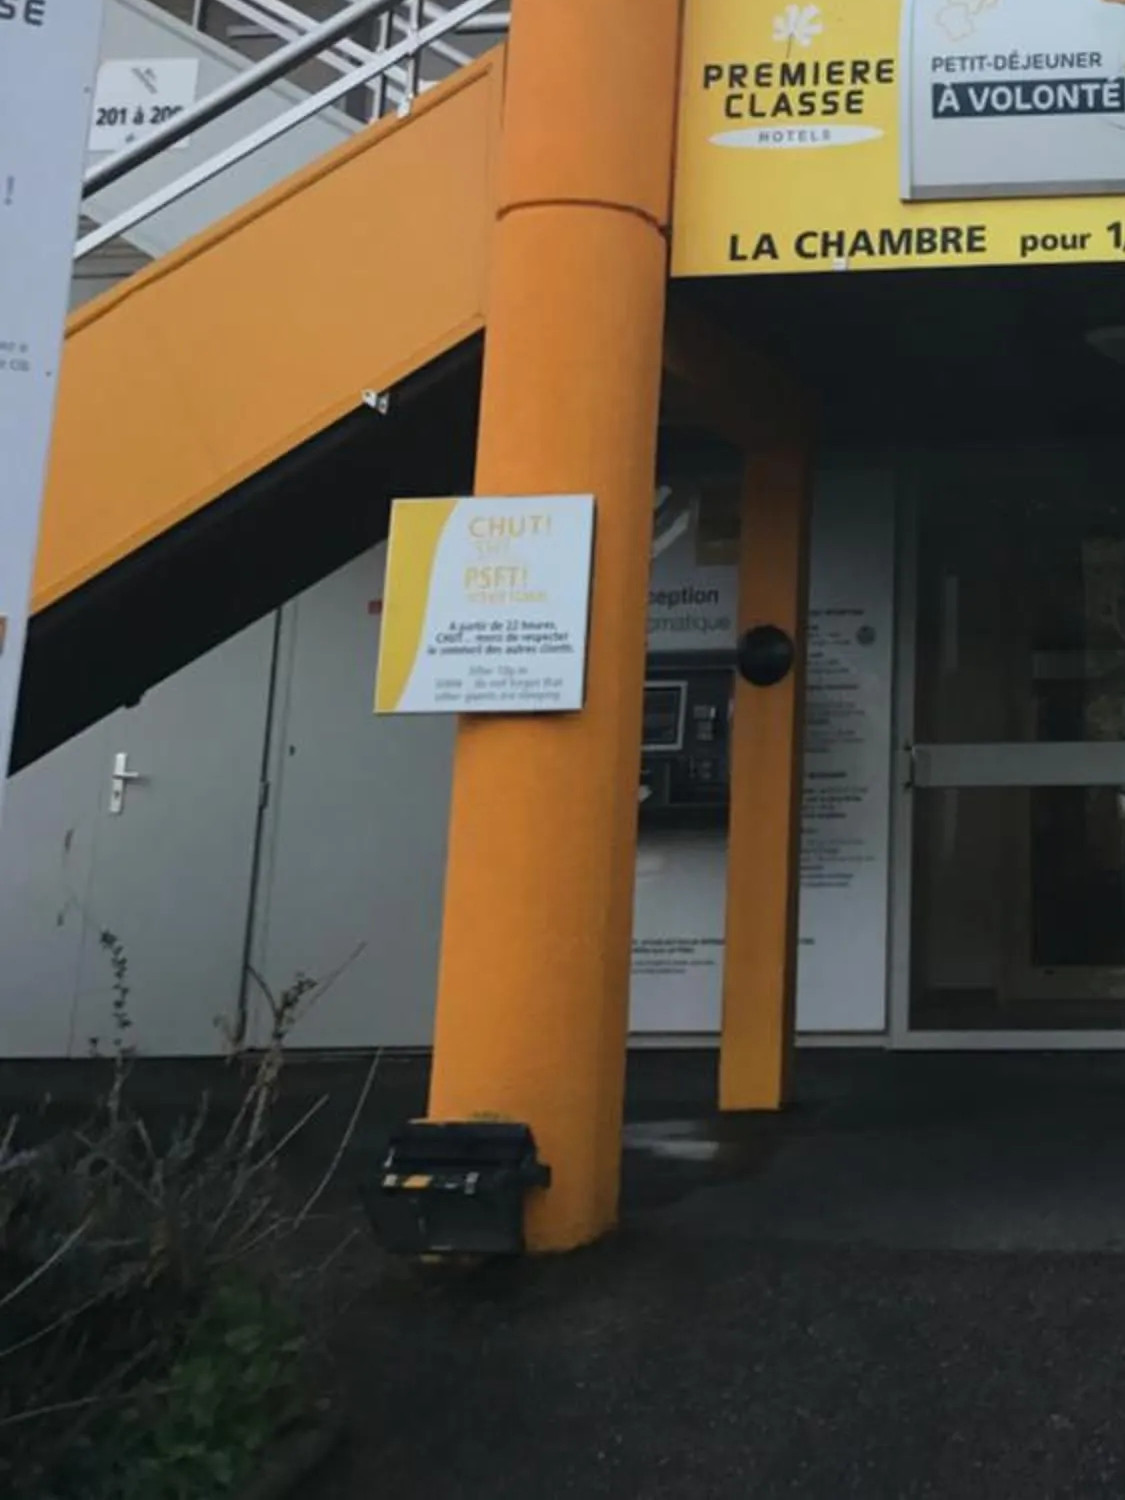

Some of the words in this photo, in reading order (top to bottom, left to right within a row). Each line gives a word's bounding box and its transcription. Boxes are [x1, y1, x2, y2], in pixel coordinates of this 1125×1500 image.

[703, 59, 895, 89] PREMIERE
[931, 50, 1103, 73] PETIT-DÉJEUNER
[725, 89, 864, 119] CLASSE
[937, 82, 961, 113] À
[968, 76, 1121, 112] VOLONTÉ
[95, 107, 127, 126] 201
[133, 105, 144, 125] à
[758, 129, 831, 144] HOTELS
[729, 233, 779, 261] LA
[794, 226, 988, 259] CHAMBRE
[1020, 230, 1091, 258] pour
[468, 514, 552, 538] CHUT!
